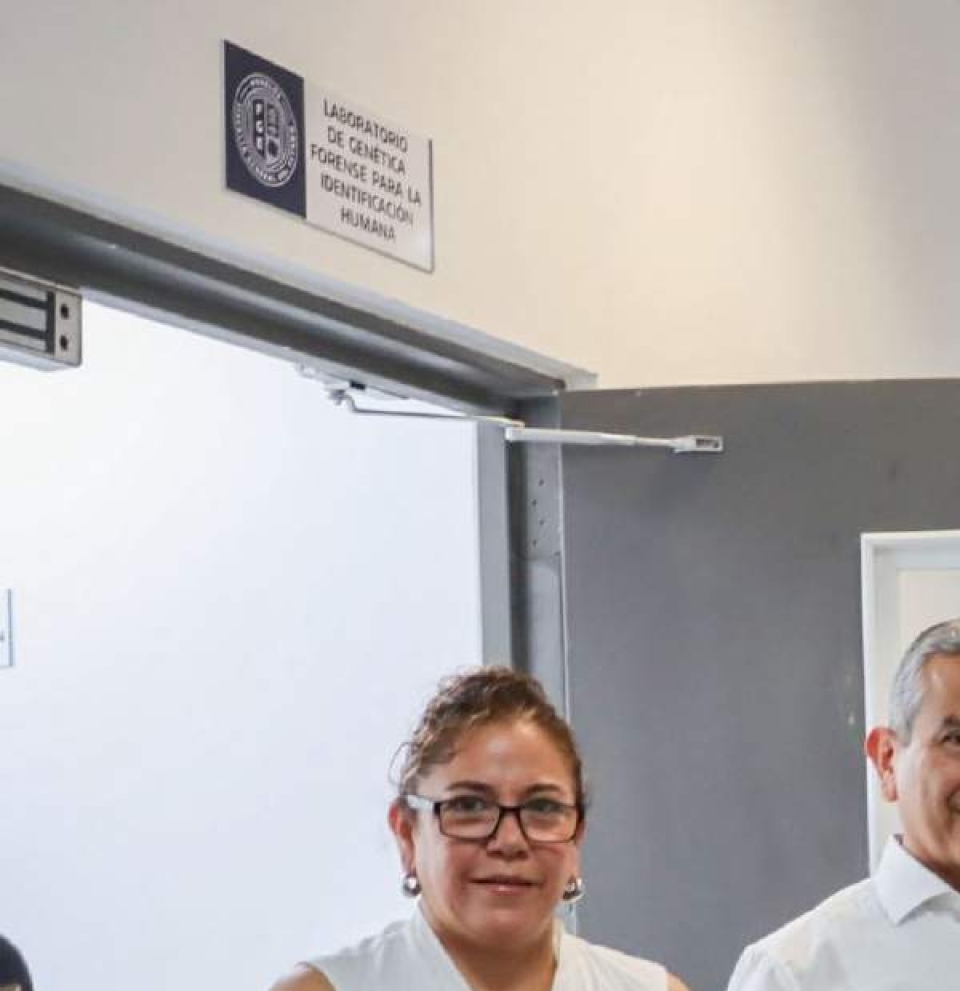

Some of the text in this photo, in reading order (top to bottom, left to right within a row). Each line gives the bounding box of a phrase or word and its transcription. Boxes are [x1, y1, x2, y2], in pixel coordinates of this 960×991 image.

[323, 98, 408, 153] LABORATORIO
[327, 126, 345, 149] DE
[310, 144, 421, 206] FORENSE PARA LA
[320, 172, 414, 228] IDENTIFICACIÓN
[340, 206, 396, 241] HUMANA
